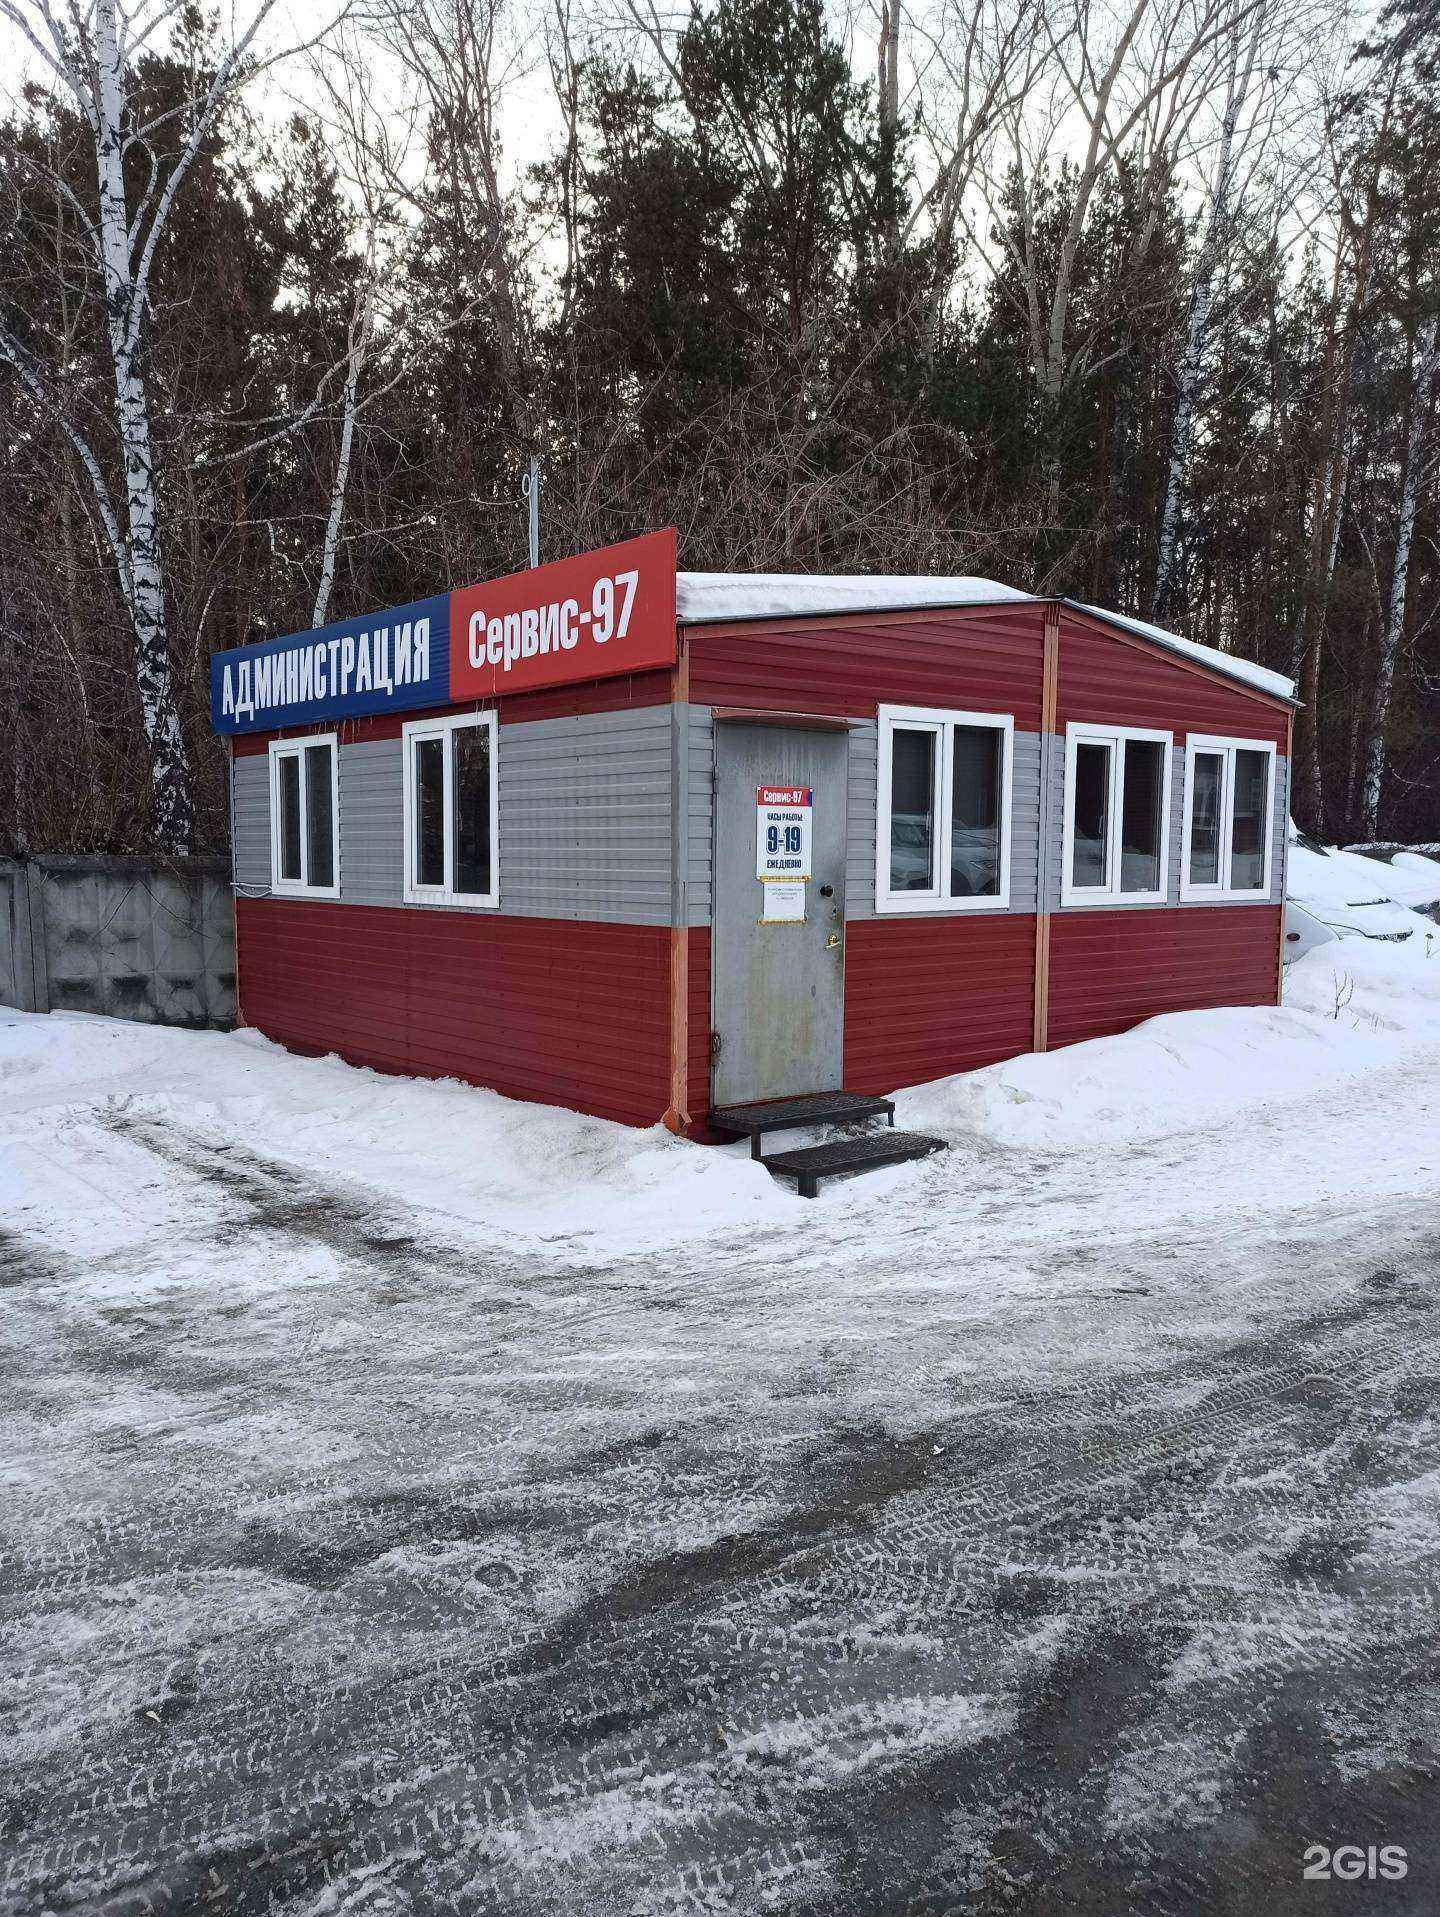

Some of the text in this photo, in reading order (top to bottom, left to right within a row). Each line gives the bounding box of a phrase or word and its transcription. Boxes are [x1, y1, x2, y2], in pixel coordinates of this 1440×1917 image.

[468, 569, 640, 672] Сервис-97
[221, 617, 431, 723] АДМИНИСТРАЦИЯ
[764, 790, 802, 803] Сервис-97
[767, 825, 801, 853] 9-19
[767, 859, 801, 870] ЕЖЕДНЕВНО
